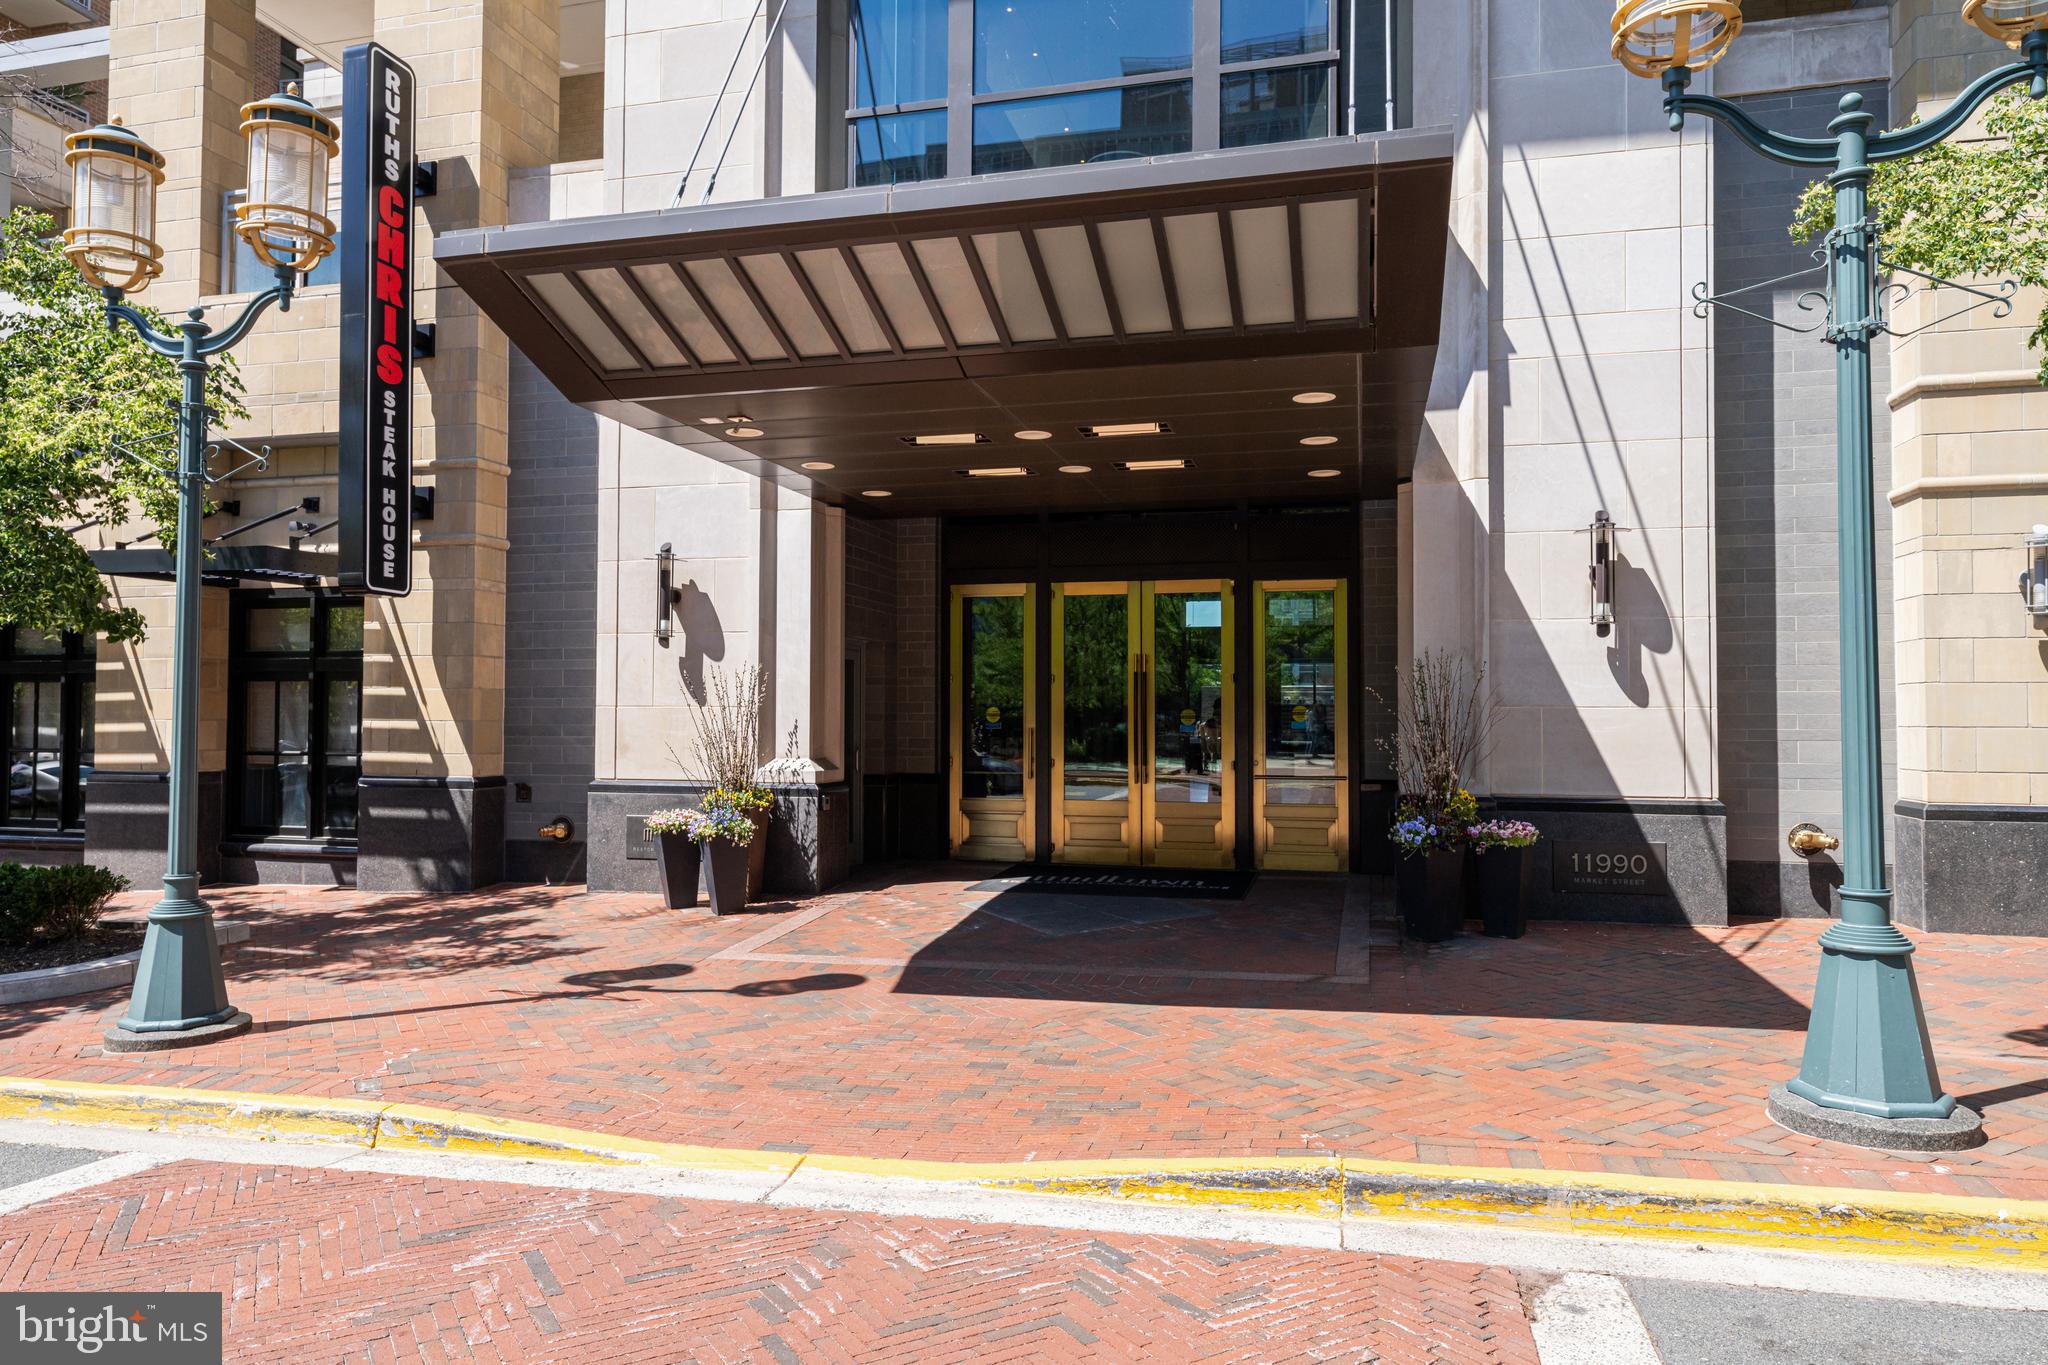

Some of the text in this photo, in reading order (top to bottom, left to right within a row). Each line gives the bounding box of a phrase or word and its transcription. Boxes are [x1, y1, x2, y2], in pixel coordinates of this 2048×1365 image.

[376, 67, 405, 578] RUTHS CHRIS STEAK HOUSE
[1571, 853, 1648, 874] 11990
[1574, 877, 1646, 886] MARKET STREET
